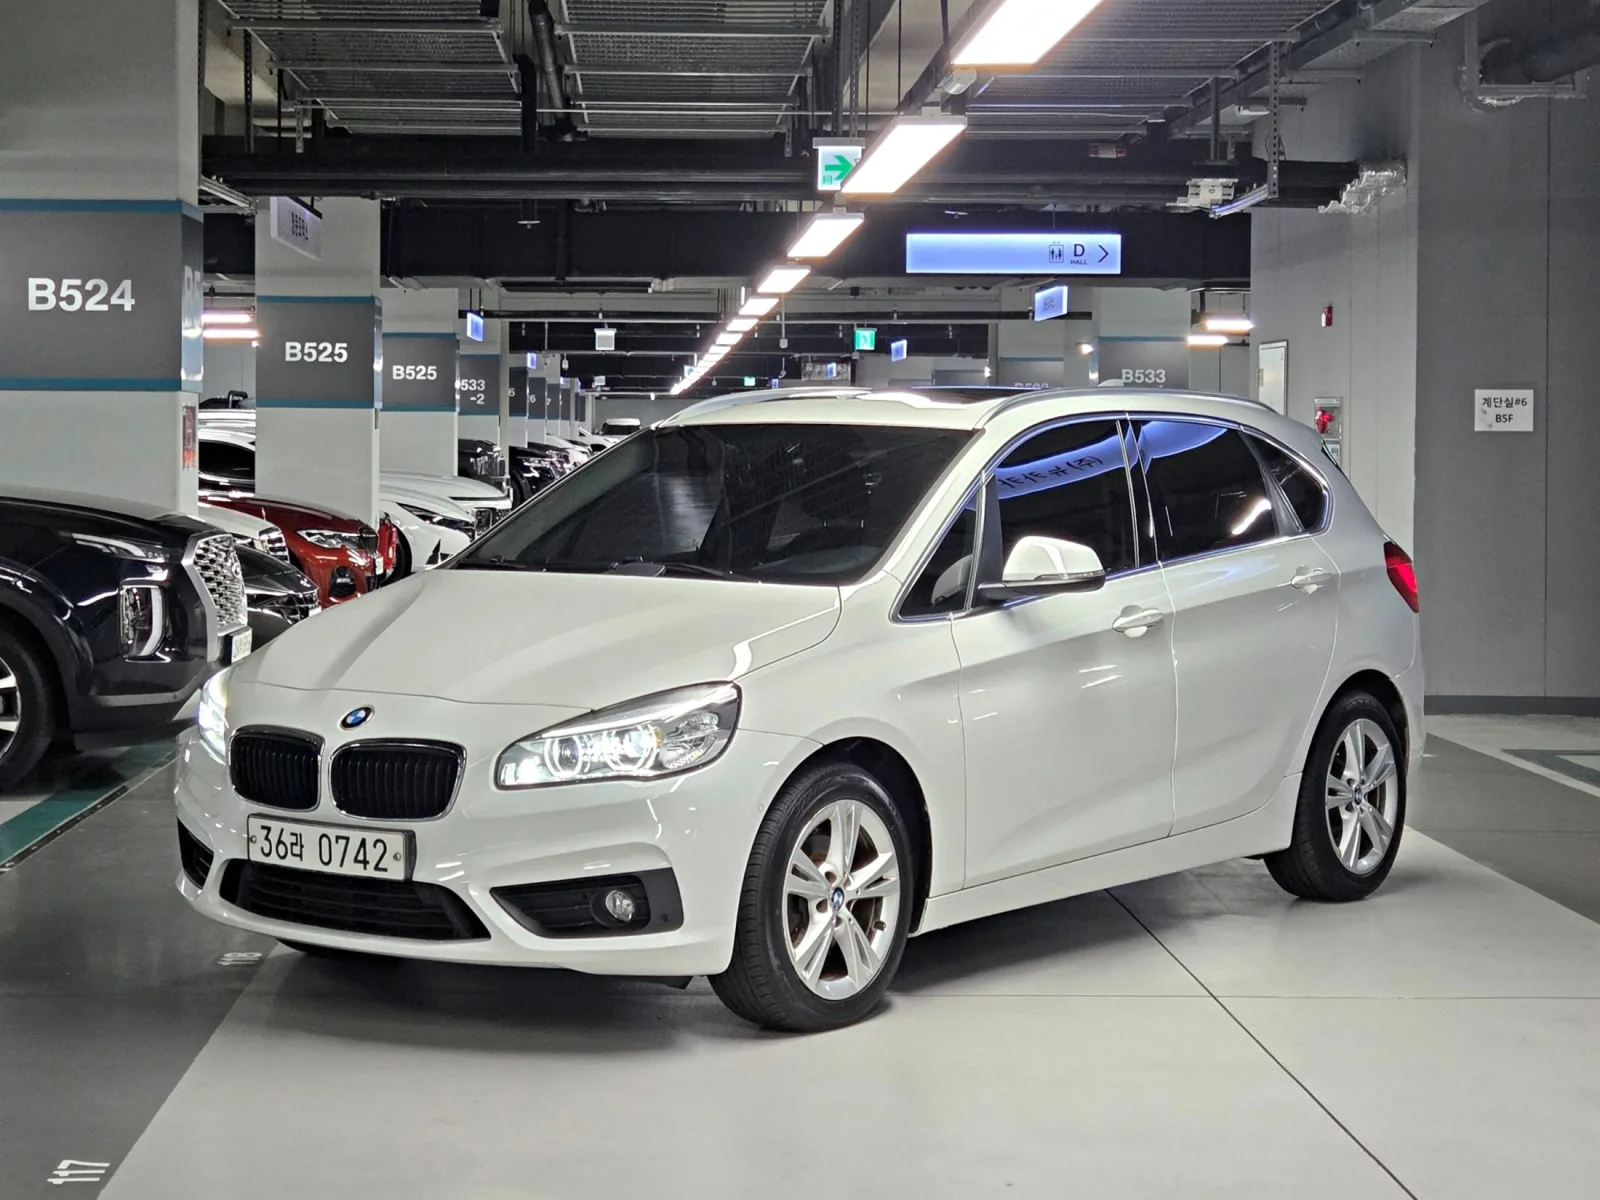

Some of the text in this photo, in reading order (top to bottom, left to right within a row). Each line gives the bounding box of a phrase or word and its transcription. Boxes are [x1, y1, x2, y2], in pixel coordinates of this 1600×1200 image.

[1073, 243, 1086, 257] D
[27, 277, 135, 312] B524
[284, 341, 348, 363] B525
[392, 364, 438, 381] B525
[1122, 368, 1166, 383] B533
[470, 393, 485, 405] -2
[1481, 396, 1528, 408] 계단실#6
[1495, 413, 1514, 424] B5F
[260, 825, 389, 873] 36라 0742
[47, 1158, 111, 1185] 117
